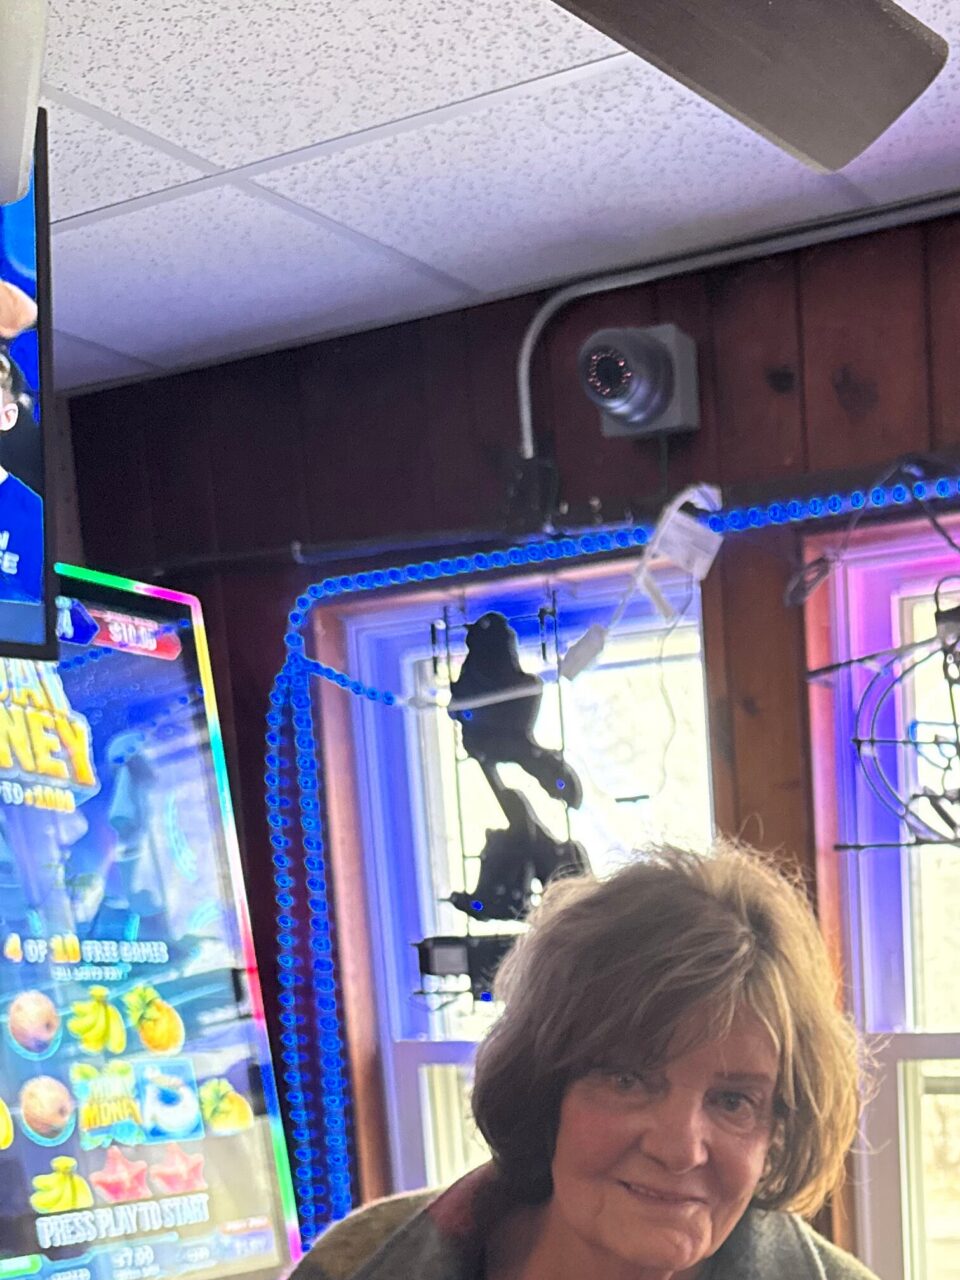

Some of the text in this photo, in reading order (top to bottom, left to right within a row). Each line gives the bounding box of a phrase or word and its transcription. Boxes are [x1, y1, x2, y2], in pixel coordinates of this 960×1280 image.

[36, 1193, 209, 1248] PRESS PLAY TO START
